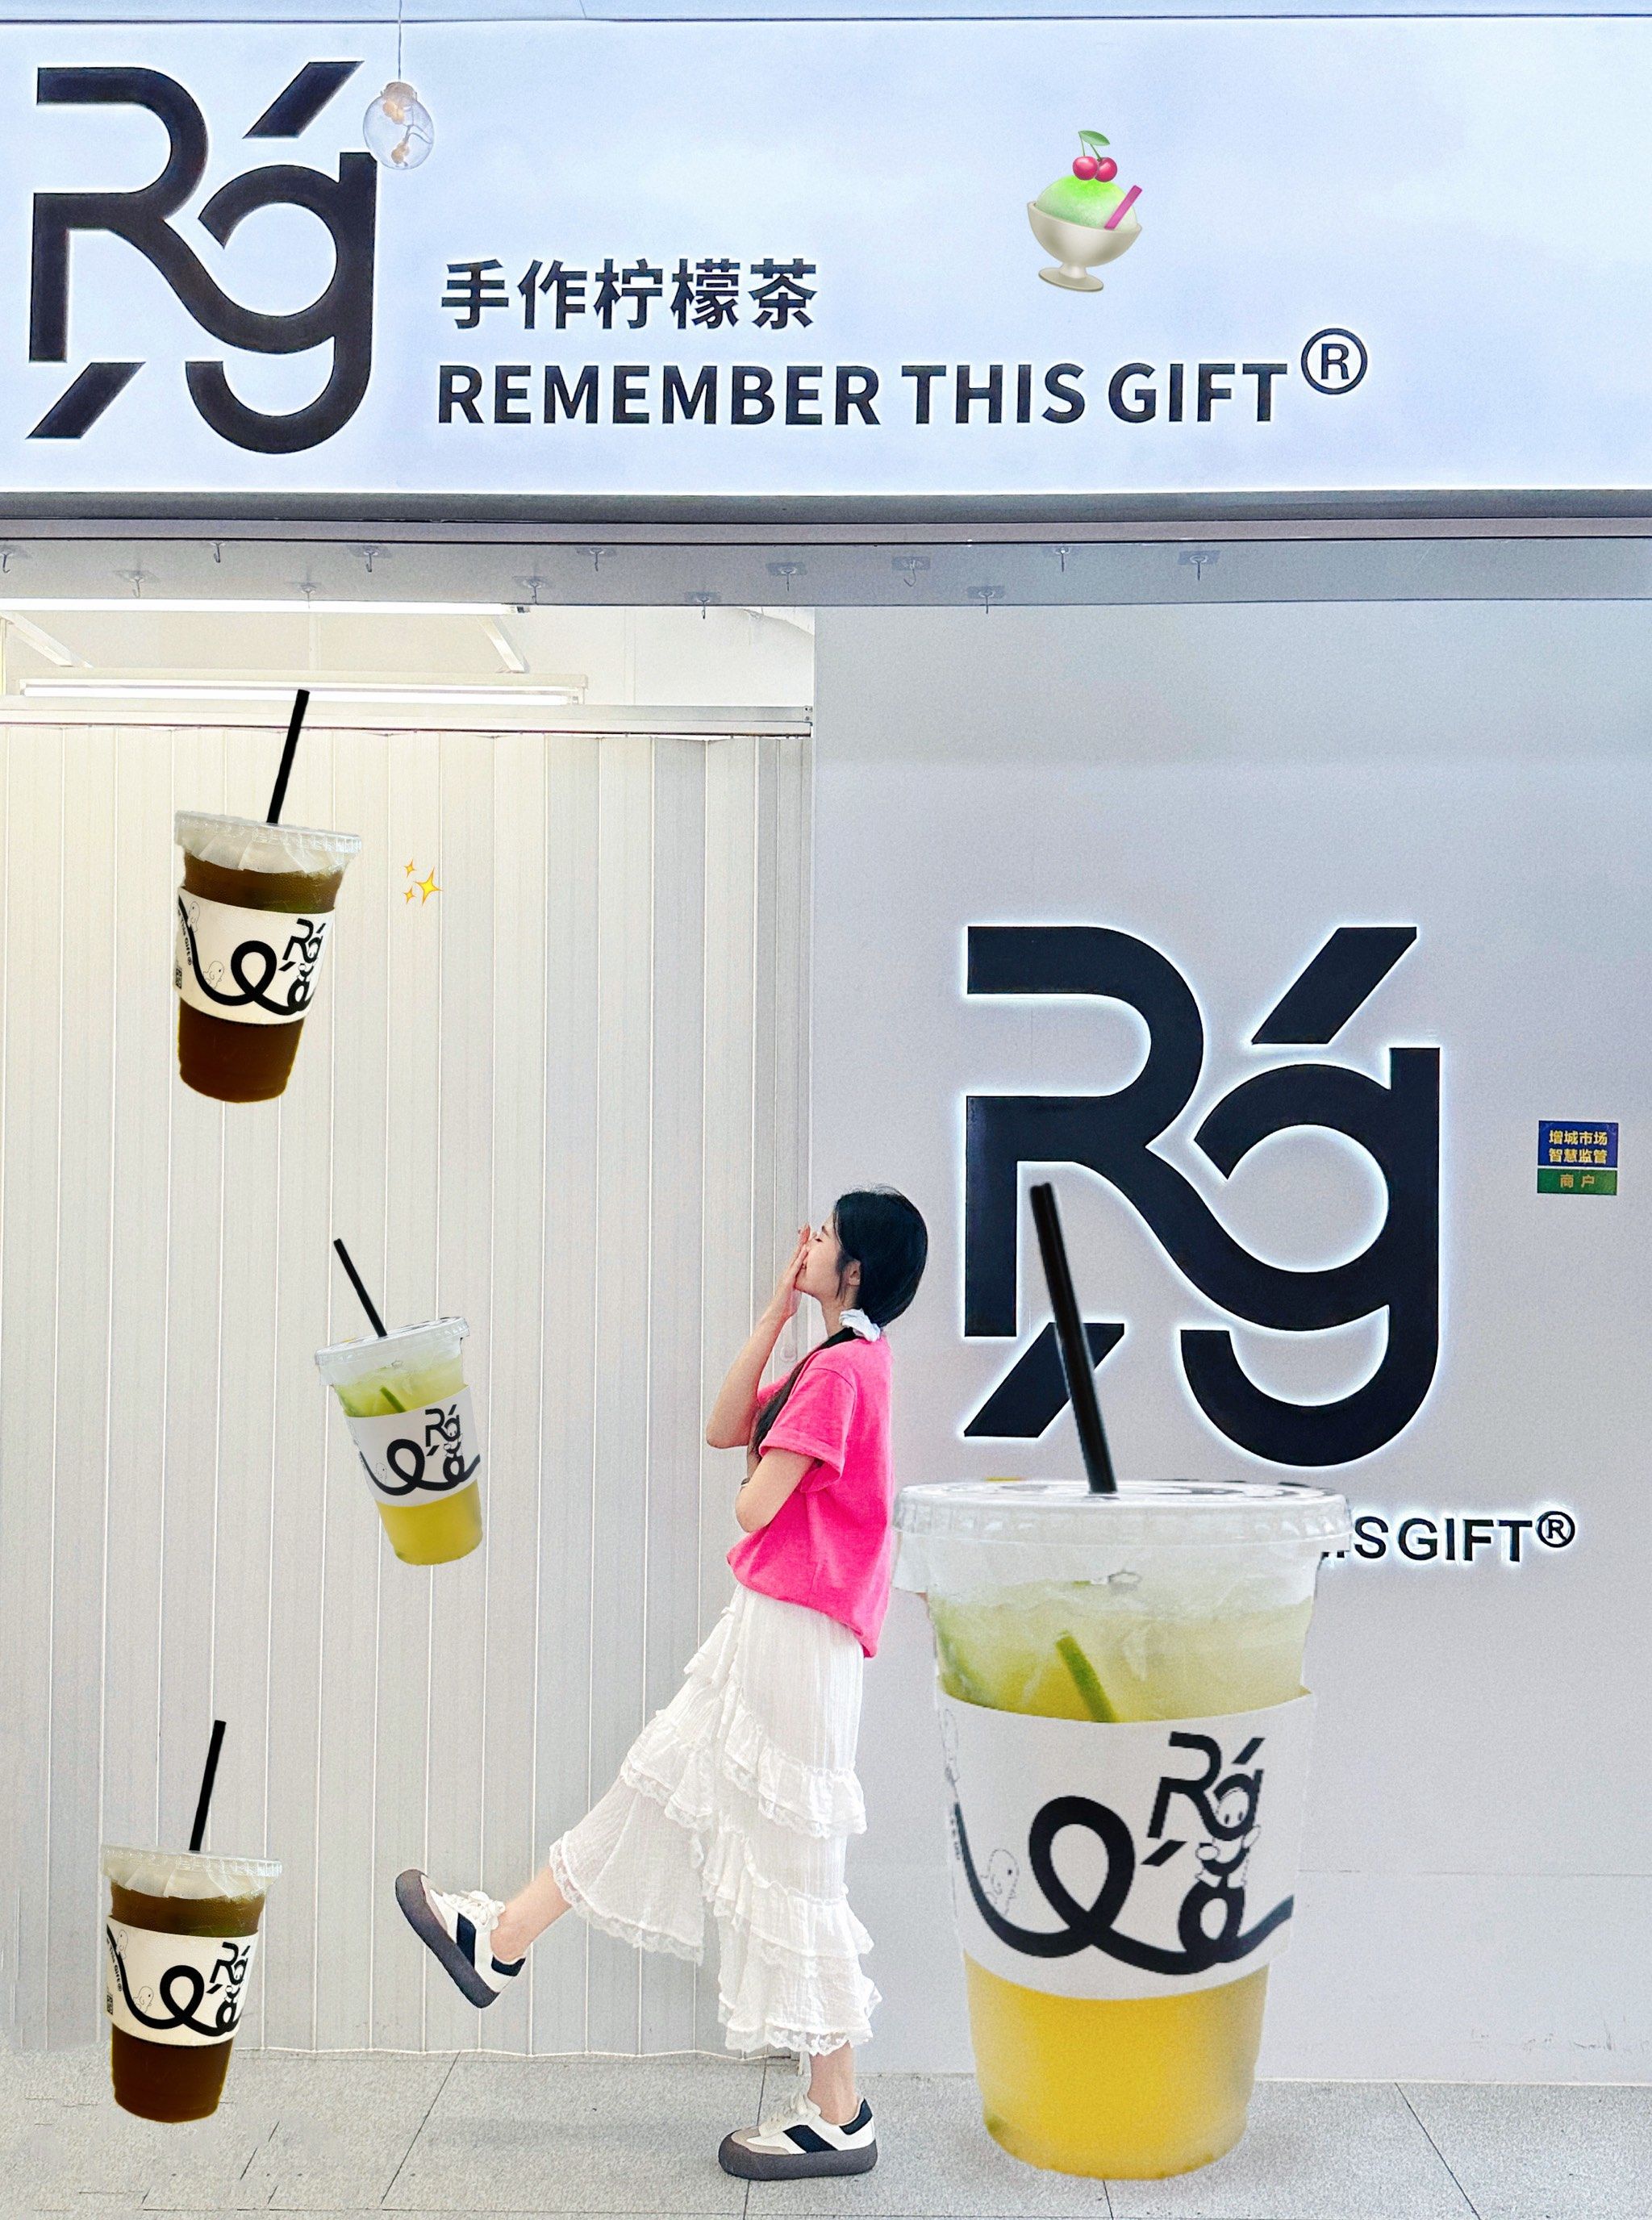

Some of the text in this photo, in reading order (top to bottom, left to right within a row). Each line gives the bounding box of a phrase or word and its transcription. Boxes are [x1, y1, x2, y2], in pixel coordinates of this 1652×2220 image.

[441, 257, 817, 330] 手作柠檬茶
[438, 365, 881, 425] REMEMBER
[900, 363, 1086, 424] THIS
[1548, 1129, 1608, 1145] 增城市场
[1548, 1147, 1608, 1164] 智慧监管
